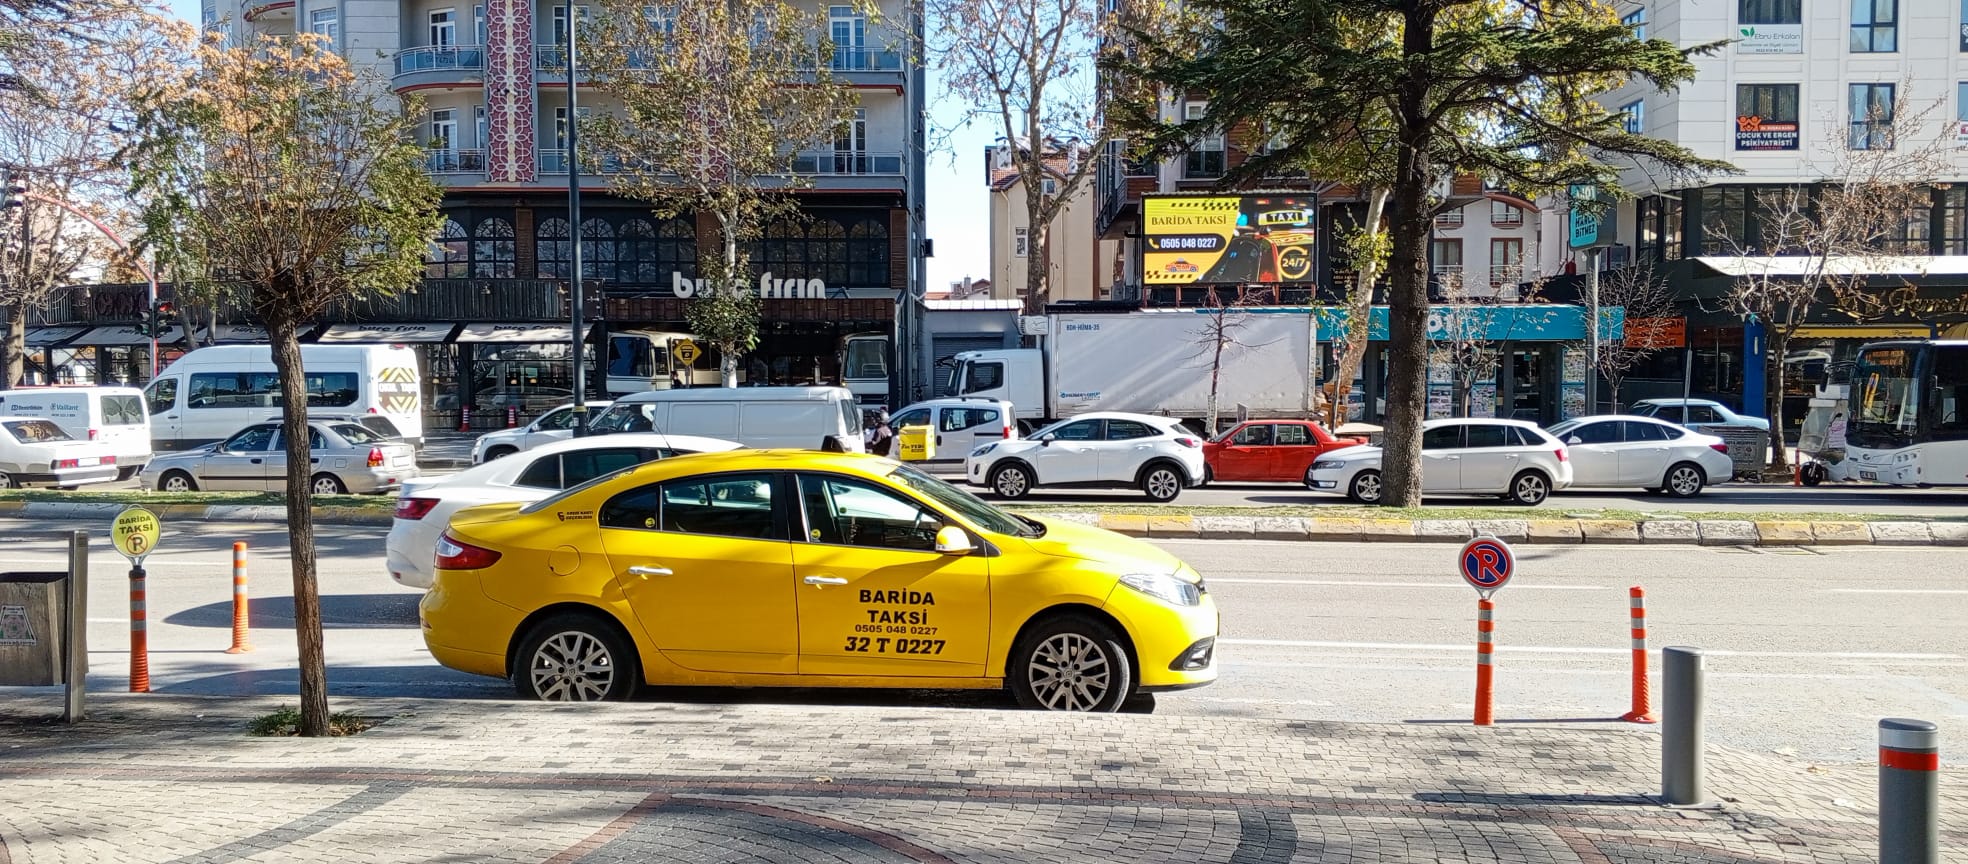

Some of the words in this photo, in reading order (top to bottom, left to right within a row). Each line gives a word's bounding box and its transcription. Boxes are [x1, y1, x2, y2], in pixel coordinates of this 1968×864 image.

[1736, 132, 1762, 140] ÇOCUK
[1151, 215, 1193, 226] BARİDA
[1194, 214, 1227, 225] TAKSİ
[1270, 212, 1300, 222] TAXI
[1160, 238, 1180, 249] 0505
[1181, 238, 1197, 249] 048
[1197, 237, 1218, 248] 0227
[1282, 257, 1306, 267] 24/7
[56, 403, 79, 411] Vaillant
[119, 516, 151, 524] BARİDA
[119, 522, 153, 534] TAKSİ
[859, 587, 935, 606] BARİDA
[867, 608, 928, 625] TAKSİ
[855, 624, 882, 633] 0505
[886, 625, 907, 634] 048
[911, 626, 938, 635] 0227
[844, 636, 870, 652] 32
[876, 637, 891, 653] T
[895, 638, 946, 655] 0227
